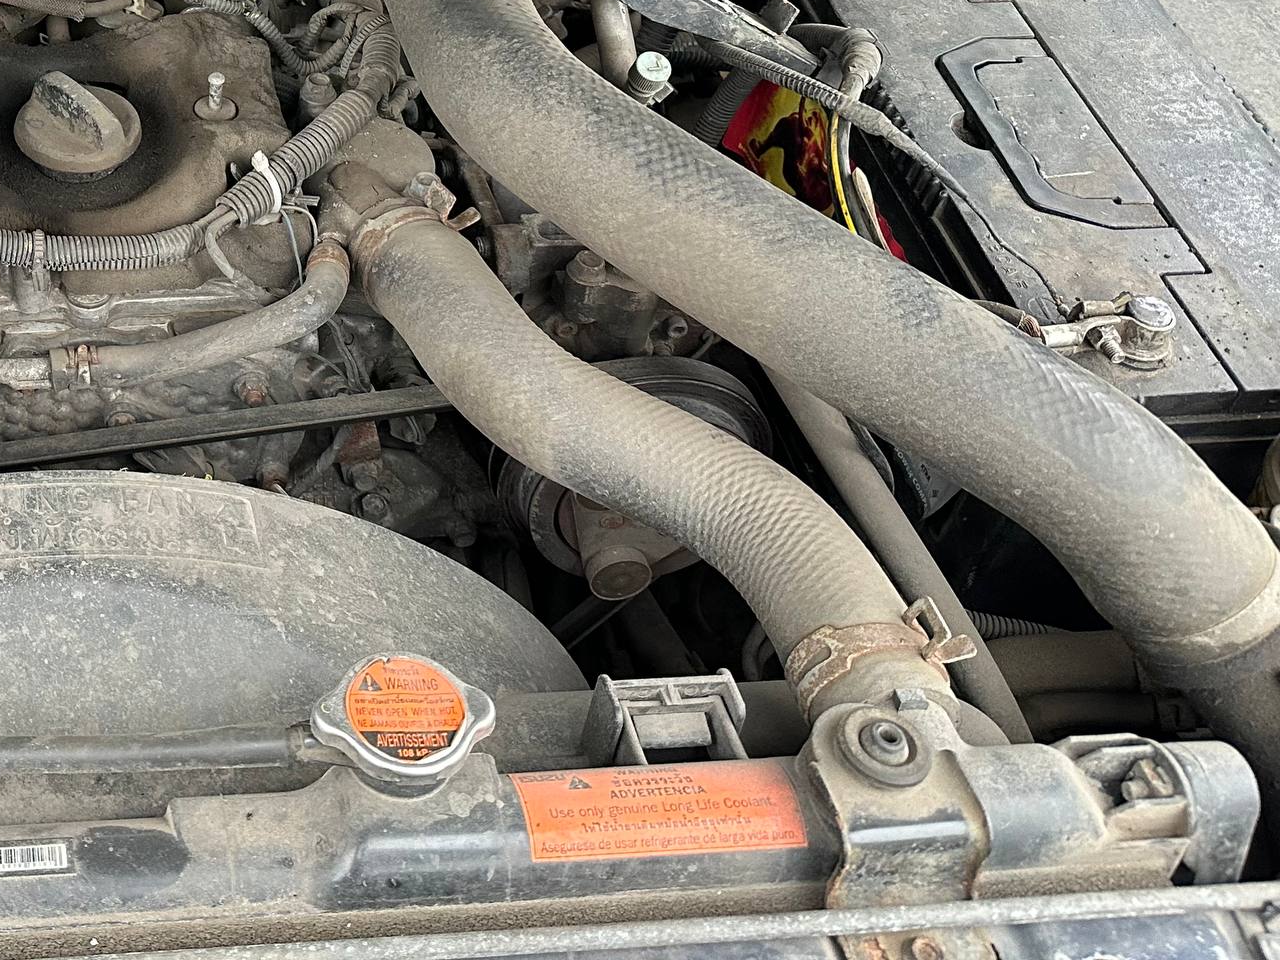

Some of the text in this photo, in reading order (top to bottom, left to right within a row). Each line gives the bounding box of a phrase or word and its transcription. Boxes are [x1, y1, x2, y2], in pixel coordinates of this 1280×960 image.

[384, 677, 438, 692] WARNING
[356, 706, 382, 716] NEVER
[386, 706, 408, 717] OPEN
[411, 707, 435, 716] WHEN
[377, 732, 448, 748] AVERTISSEMENT
[398, 749, 414, 758] 108
[518, 773, 566, 783] ISUZU
[610, 785, 707, 800] ADVERTENCIA
[549, 808, 575, 819] Use
[580, 806, 603, 819] only
[609, 803, 658, 818] genuine
[662, 801, 695, 814] Long
[696, 798, 720, 811] Life
[599, 839, 611, 850] de
[615, 838, 637, 849] usar
[640, 834, 700, 849] refrigerante
[703, 833, 716, 843] de
[720, 831, 745, 845] larga
[748, 830, 769, 840] vida
